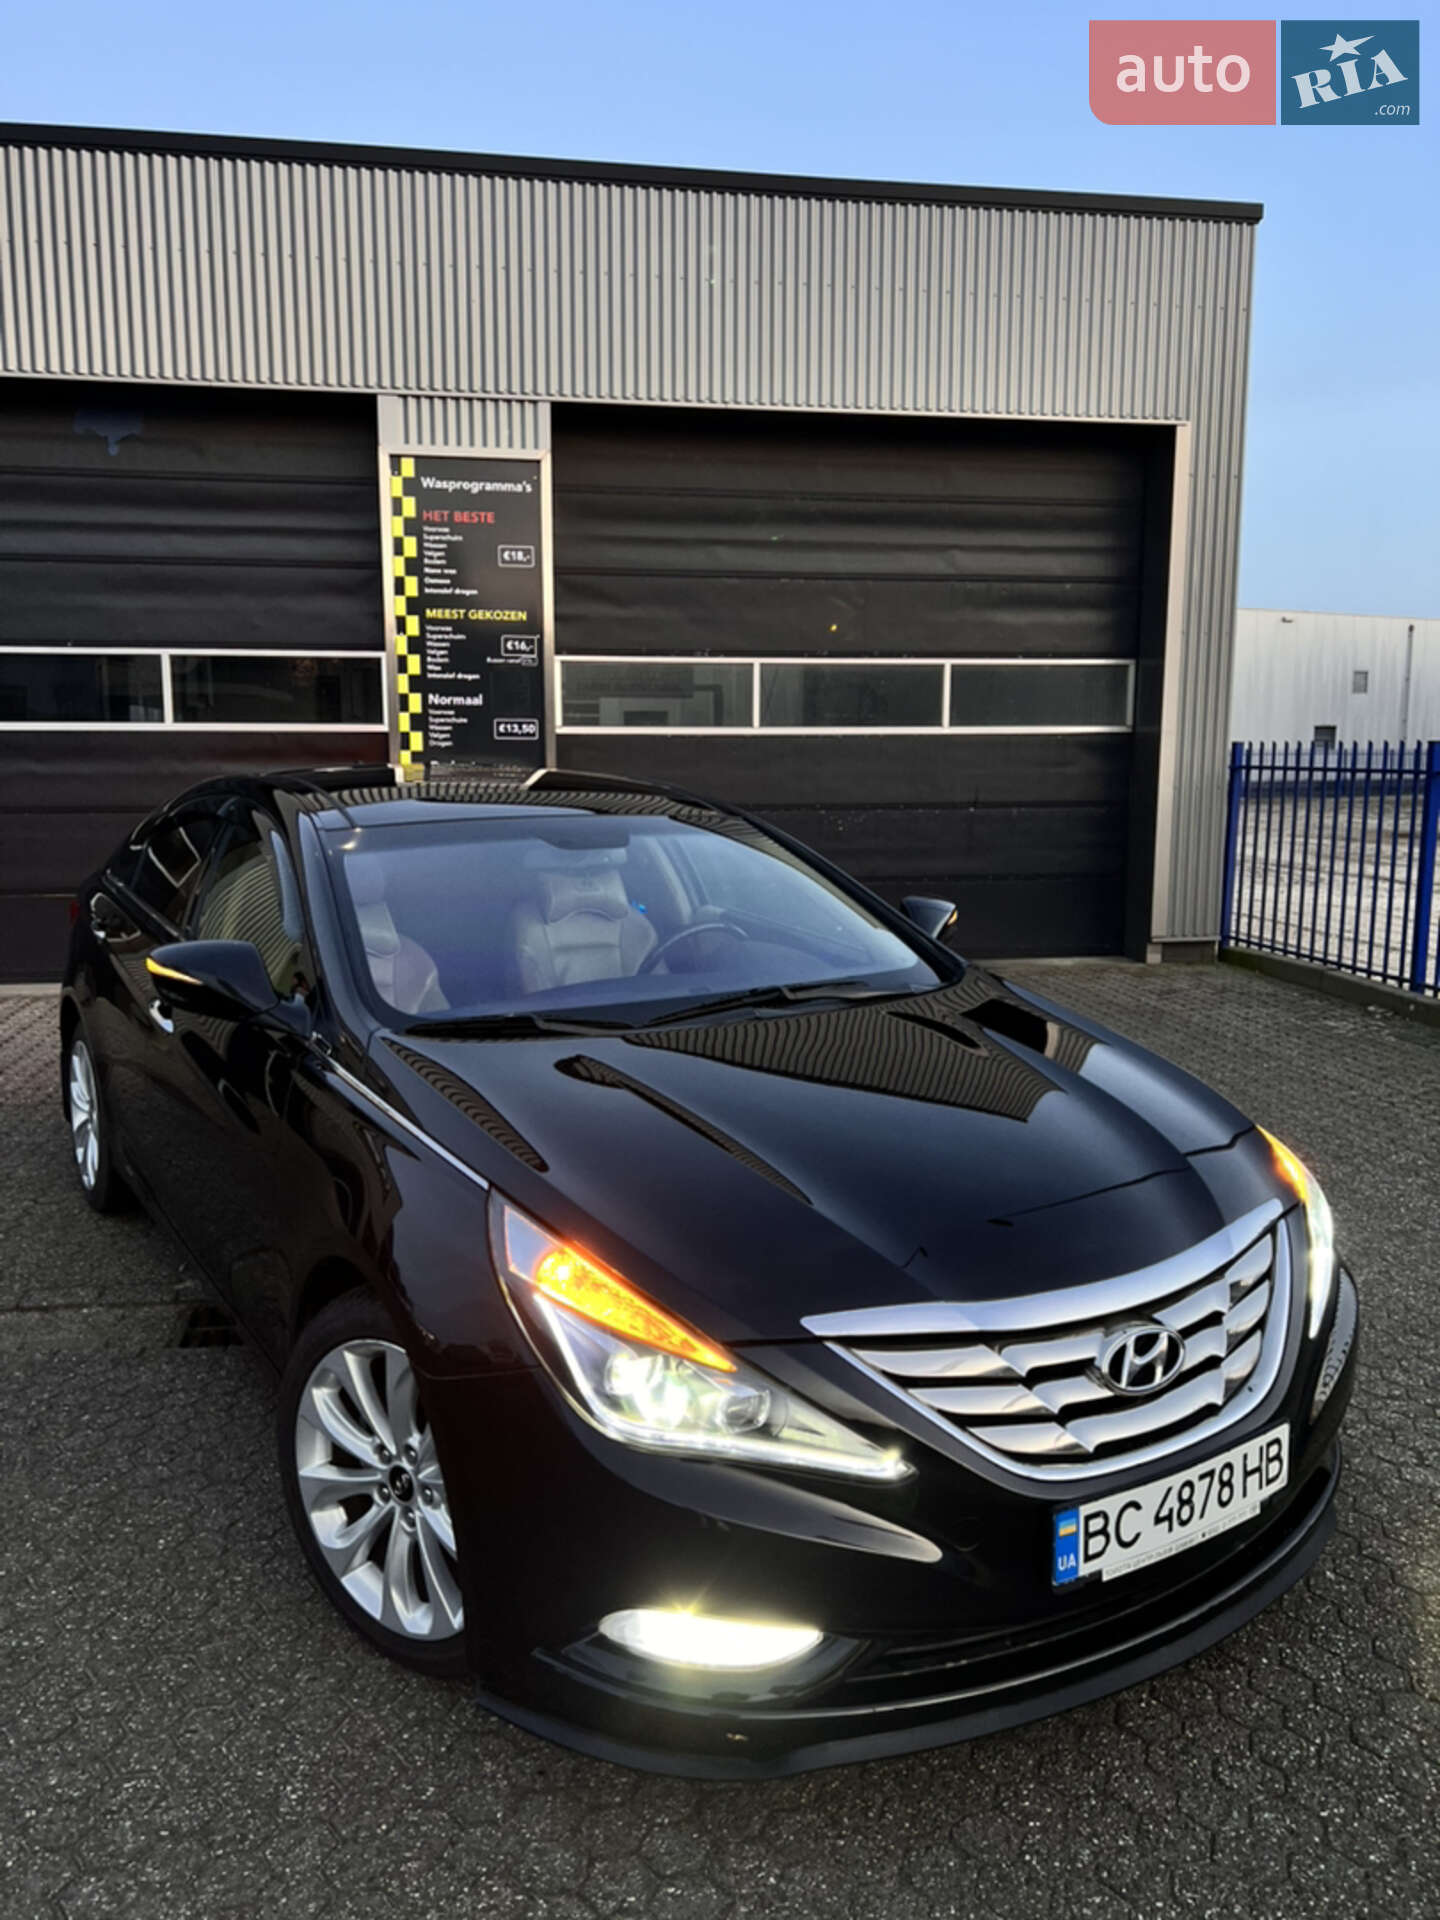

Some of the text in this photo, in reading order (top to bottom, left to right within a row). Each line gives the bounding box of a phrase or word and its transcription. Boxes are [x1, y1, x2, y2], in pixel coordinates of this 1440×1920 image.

[420, 476, 532, 494] Wasprogramma's
[422, 510, 496, 524] HET BESTE
[425, 608, 528, 622] MEEST GEKOZEN
[427, 693, 483, 706] Normaal
[498, 723, 537, 736] €13,50
[1083, 1500, 1143, 1564] BC
[1153, 1461, 1235, 1533] 4878
[1242, 1437, 1284, 1499] HB
[1058, 1553, 1077, 1571] UA
